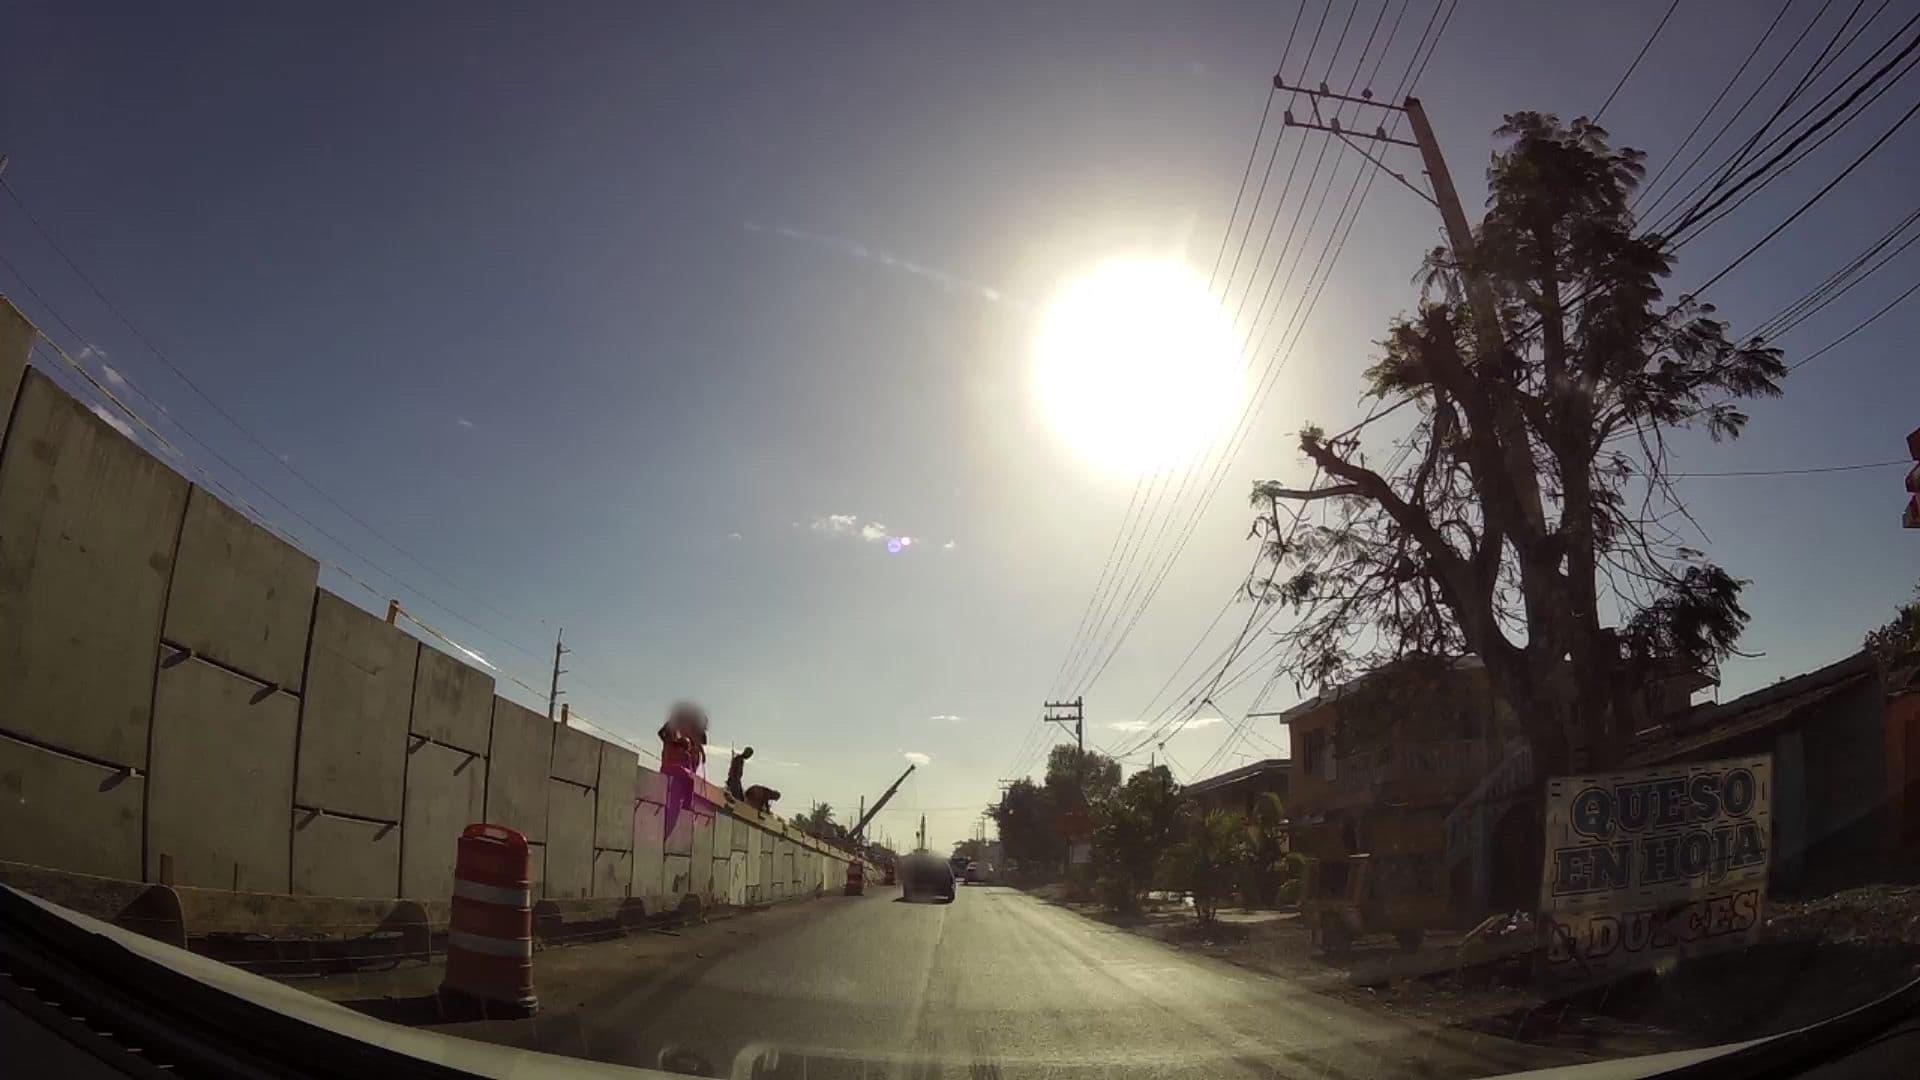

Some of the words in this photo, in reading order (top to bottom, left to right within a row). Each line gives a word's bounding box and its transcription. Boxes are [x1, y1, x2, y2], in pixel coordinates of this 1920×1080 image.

[1571, 768, 1757, 841] QUESO
[1552, 840, 1635, 897] EN
[1640, 821, 1768, 886] HOJA
